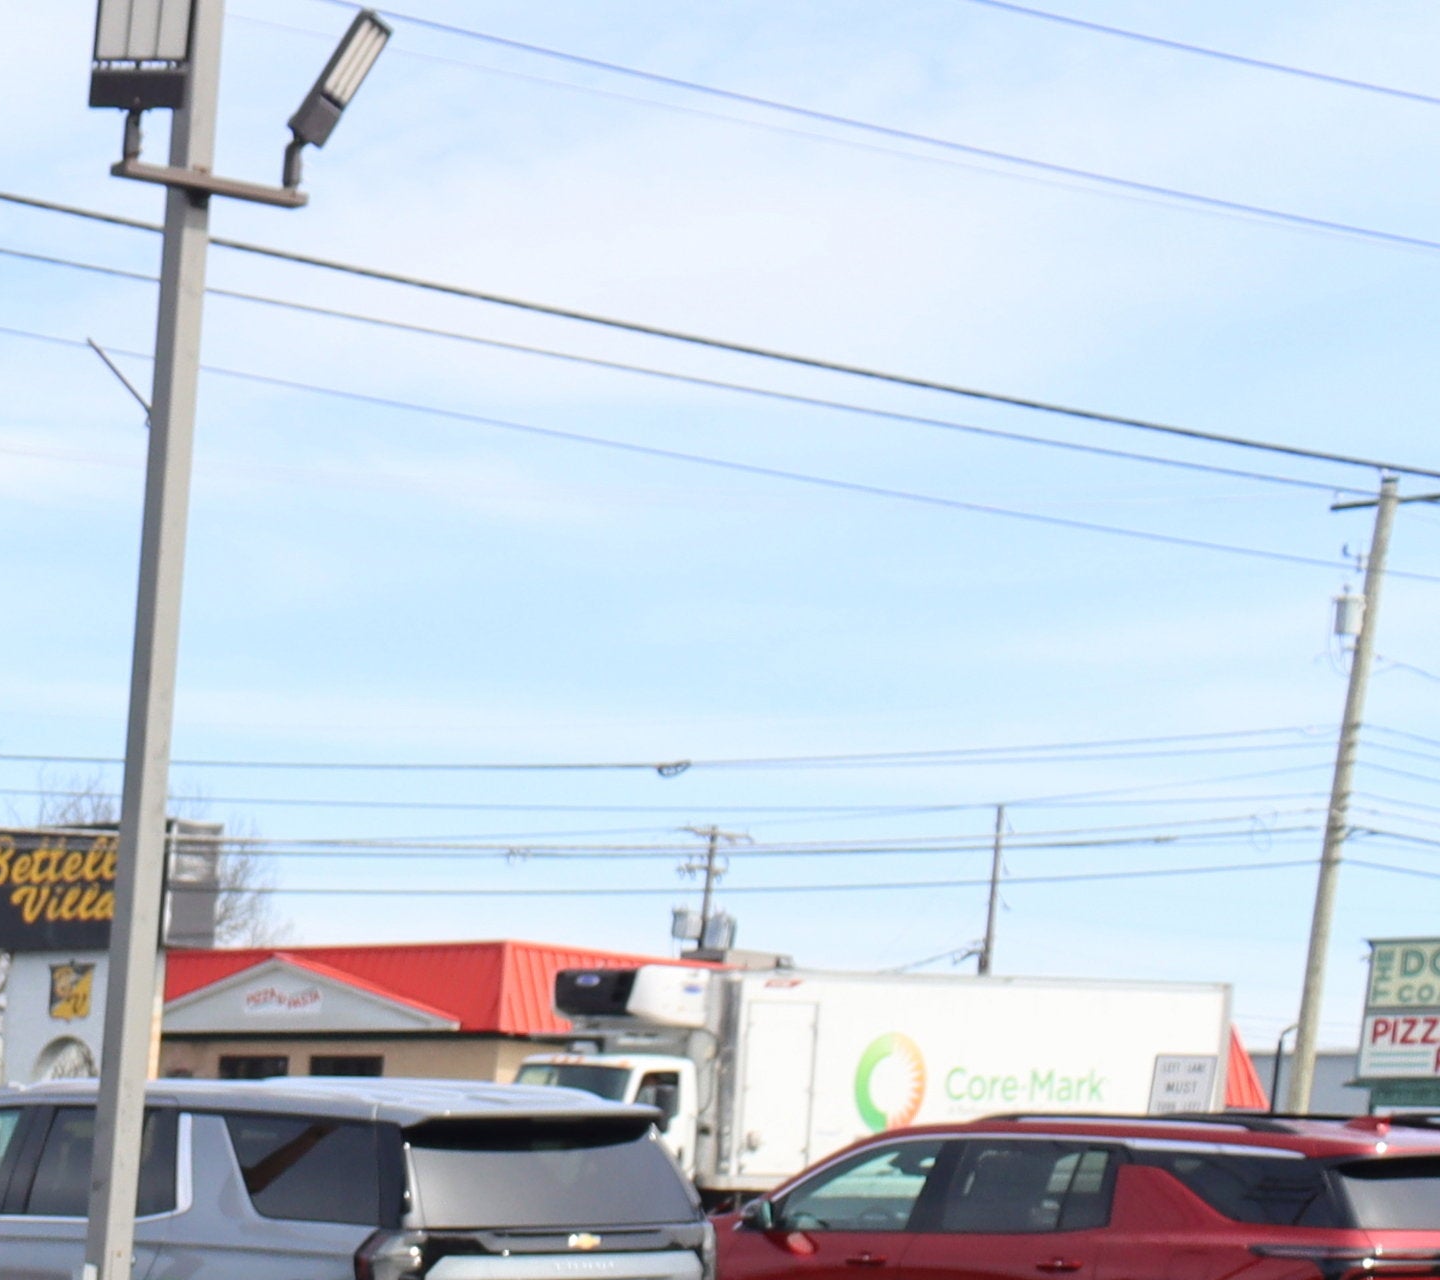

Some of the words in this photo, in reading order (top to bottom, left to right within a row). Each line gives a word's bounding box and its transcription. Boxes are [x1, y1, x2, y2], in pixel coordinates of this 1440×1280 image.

[10, 882, 116, 924] Villa
[1397, 983, 1440, 1003] CO
[1371, 1018, 1440, 1045] PIZZ
